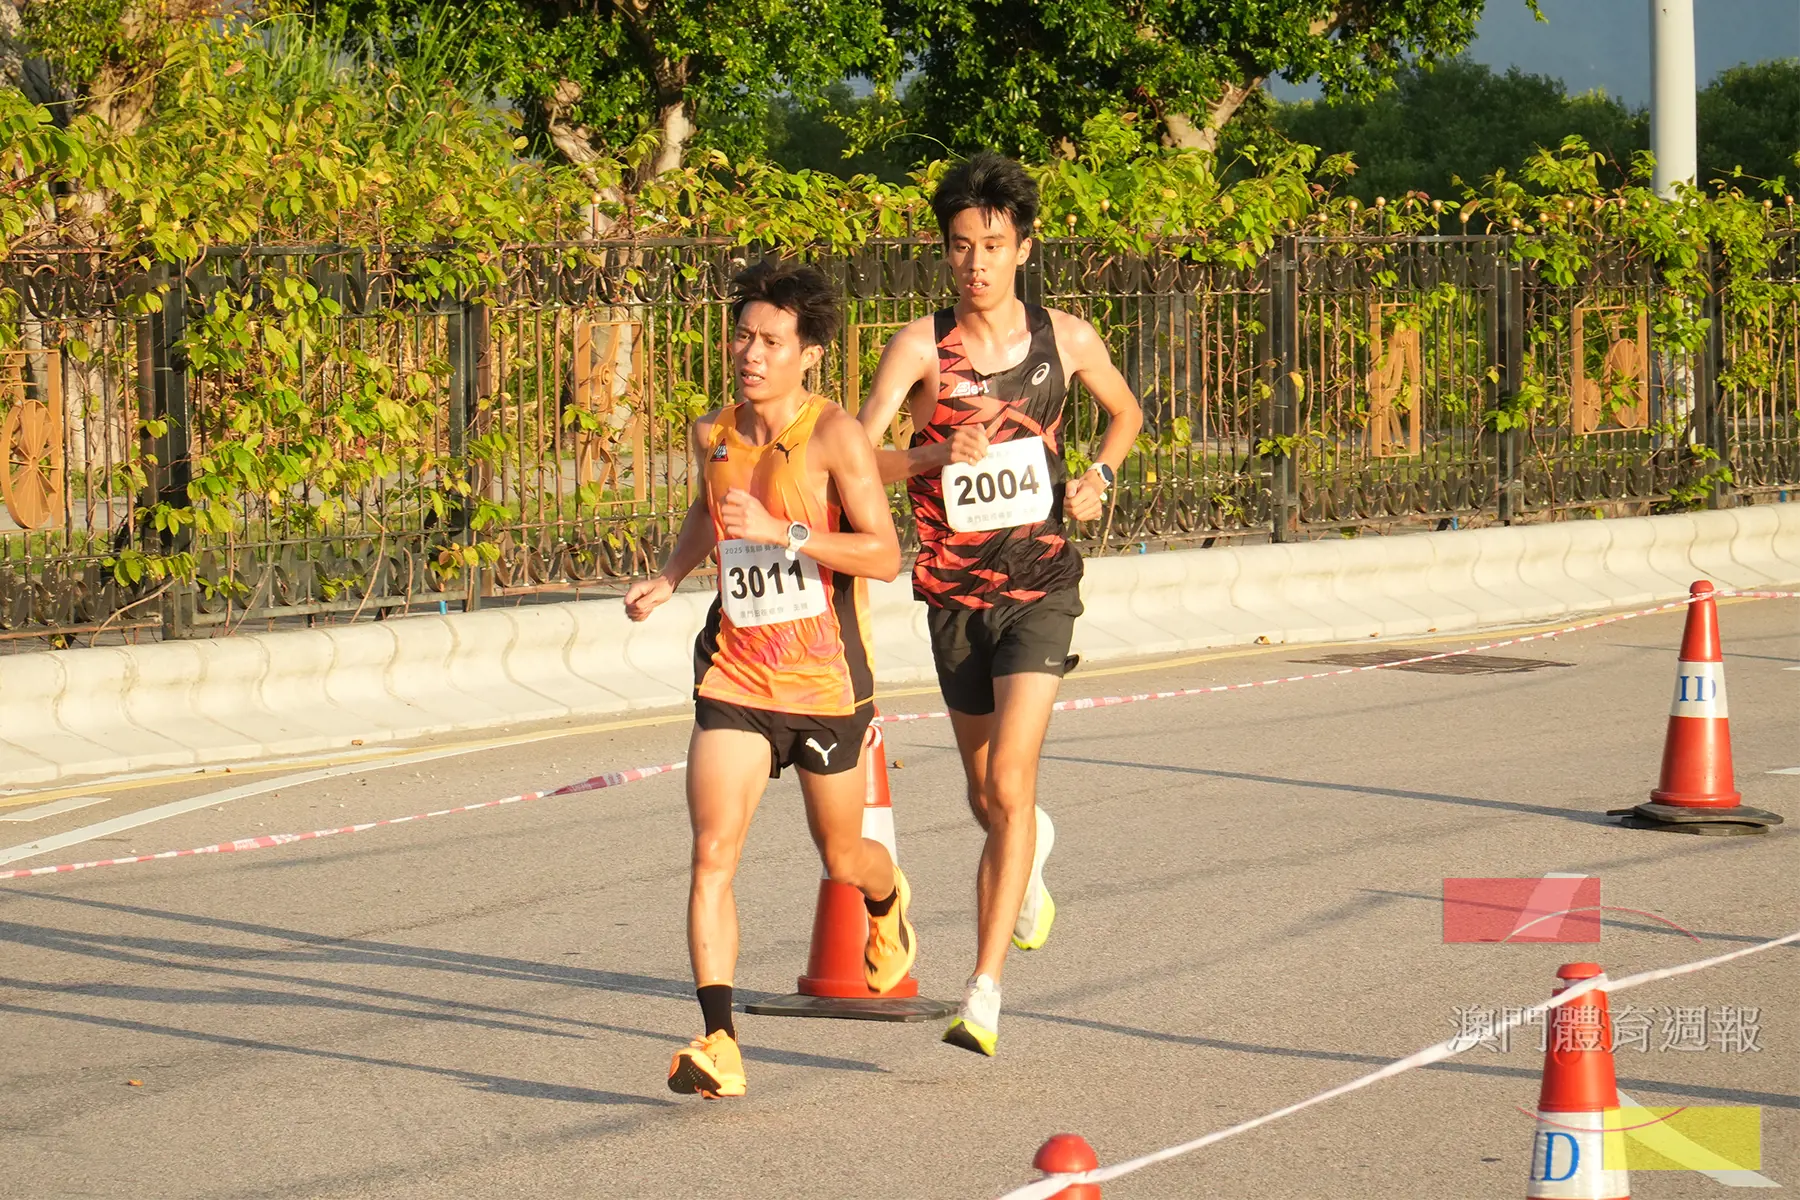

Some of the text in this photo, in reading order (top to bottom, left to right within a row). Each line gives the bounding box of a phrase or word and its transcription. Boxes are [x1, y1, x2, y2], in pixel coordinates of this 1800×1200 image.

[954, 464, 1040, 506] 2004
[724, 546, 743, 555] 2025
[728, 559, 806, 600] 3011
